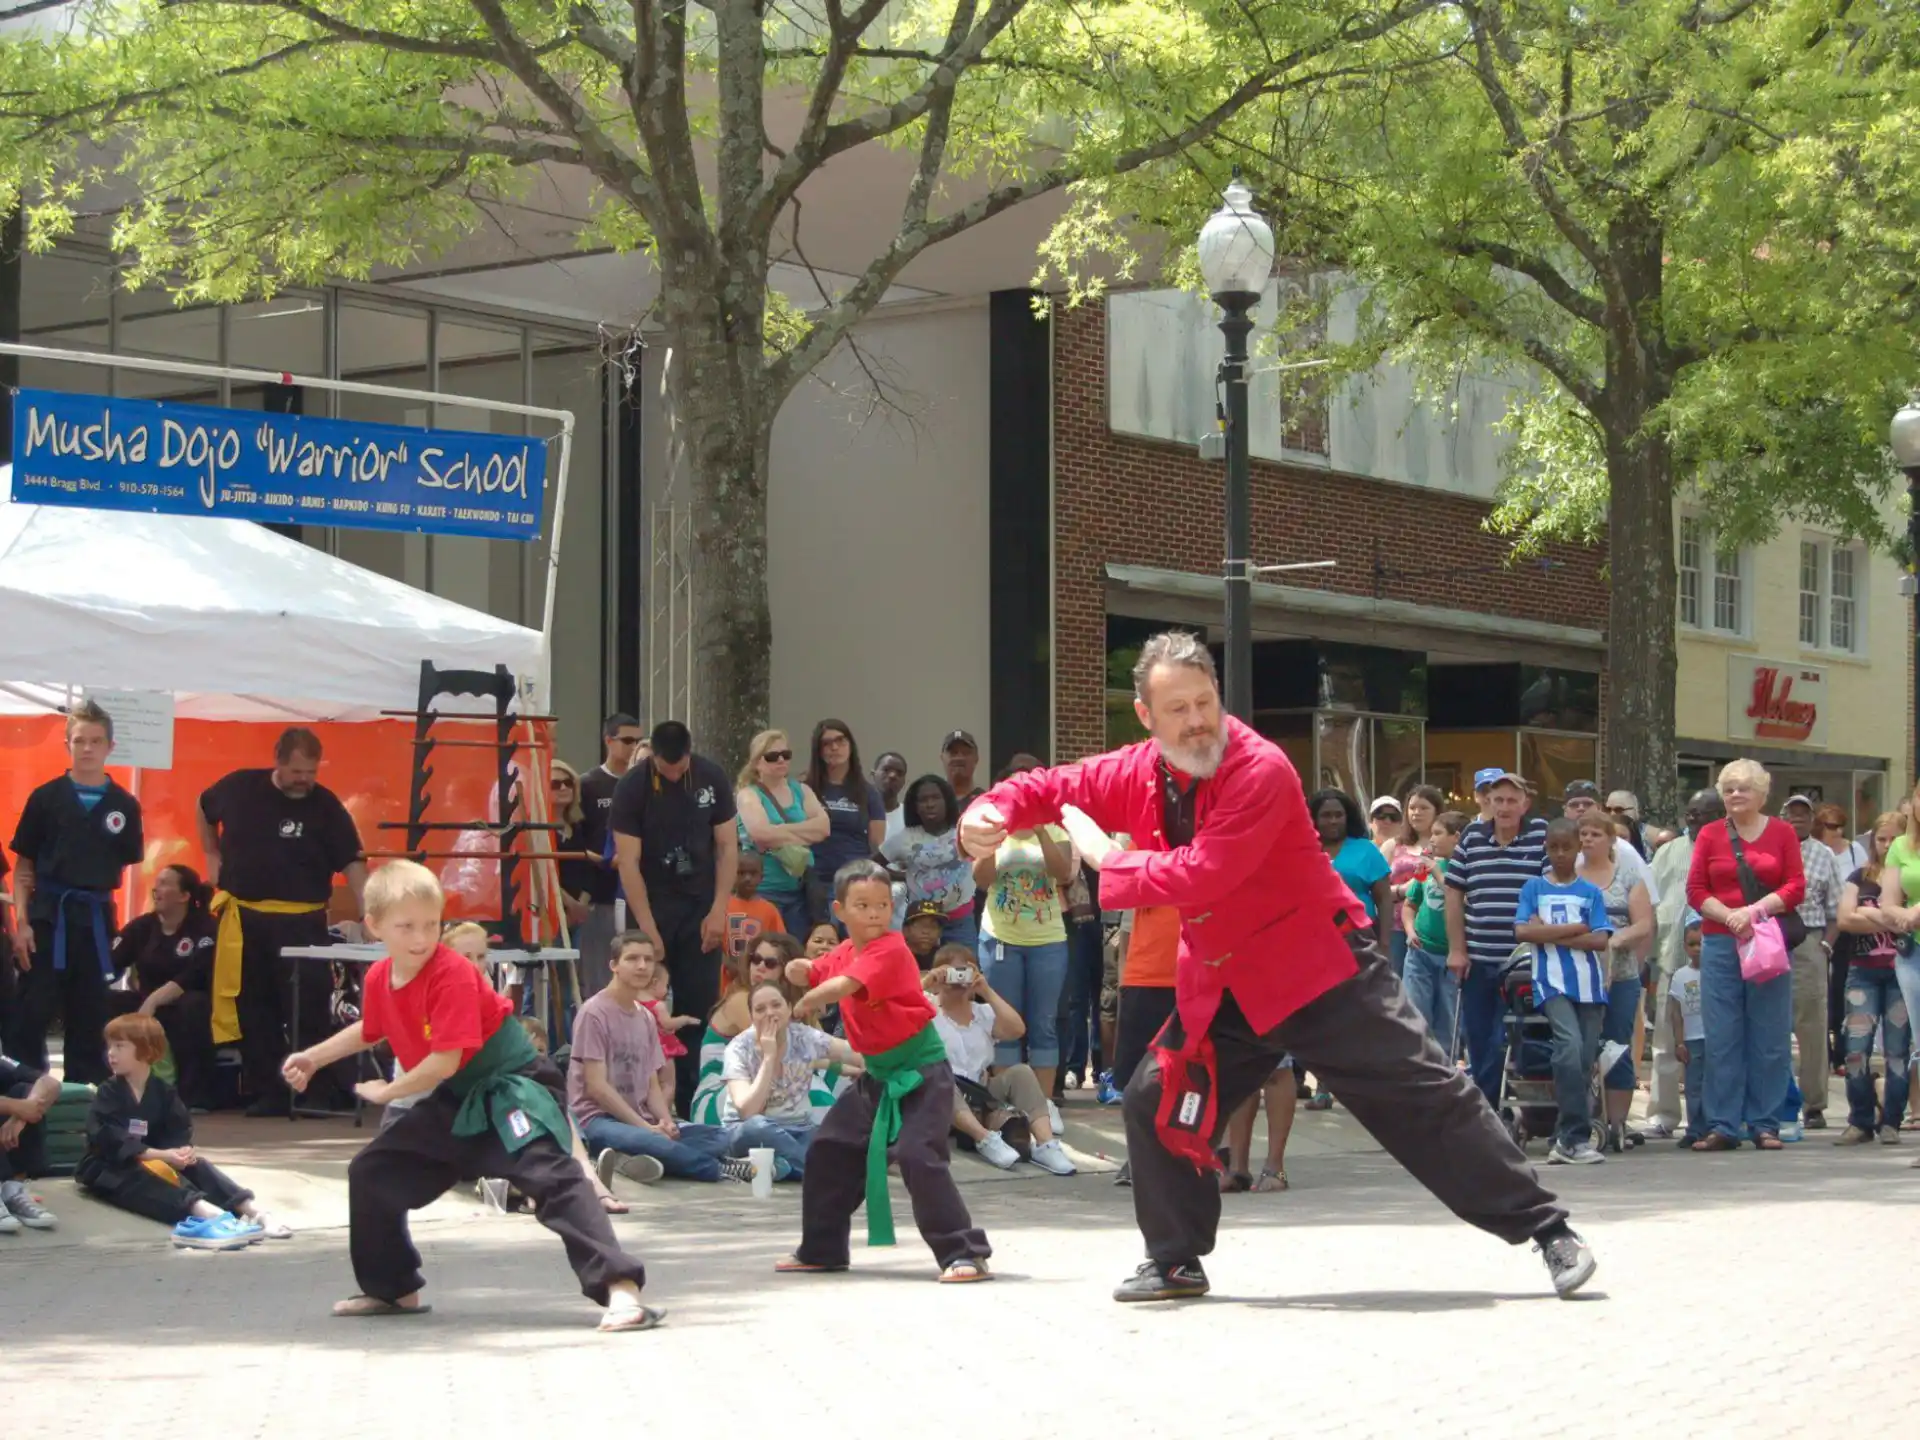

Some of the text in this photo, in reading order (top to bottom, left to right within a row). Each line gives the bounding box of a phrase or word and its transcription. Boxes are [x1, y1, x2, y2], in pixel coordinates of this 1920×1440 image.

[25, 406, 149, 465] Musha
[158, 418, 241, 509] Dojo
[416, 445, 529, 500] School
[23, 473, 48, 486] 3444
[50, 474, 77, 493] Bragg
[119, 481, 185, 498] 910-578-1564
[220, 489, 257, 504] JU-JITSU
[264, 493, 294, 507] AIKIDO
[333, 498, 369, 513] HAPKIDO
[376, 501, 398, 515] KUNG
[400, 504, 411, 515] FU
[417, 504, 447, 519] KARATE
[453, 507, 500, 523] TAEKWONDO
[507, 511, 519, 524] TAI
